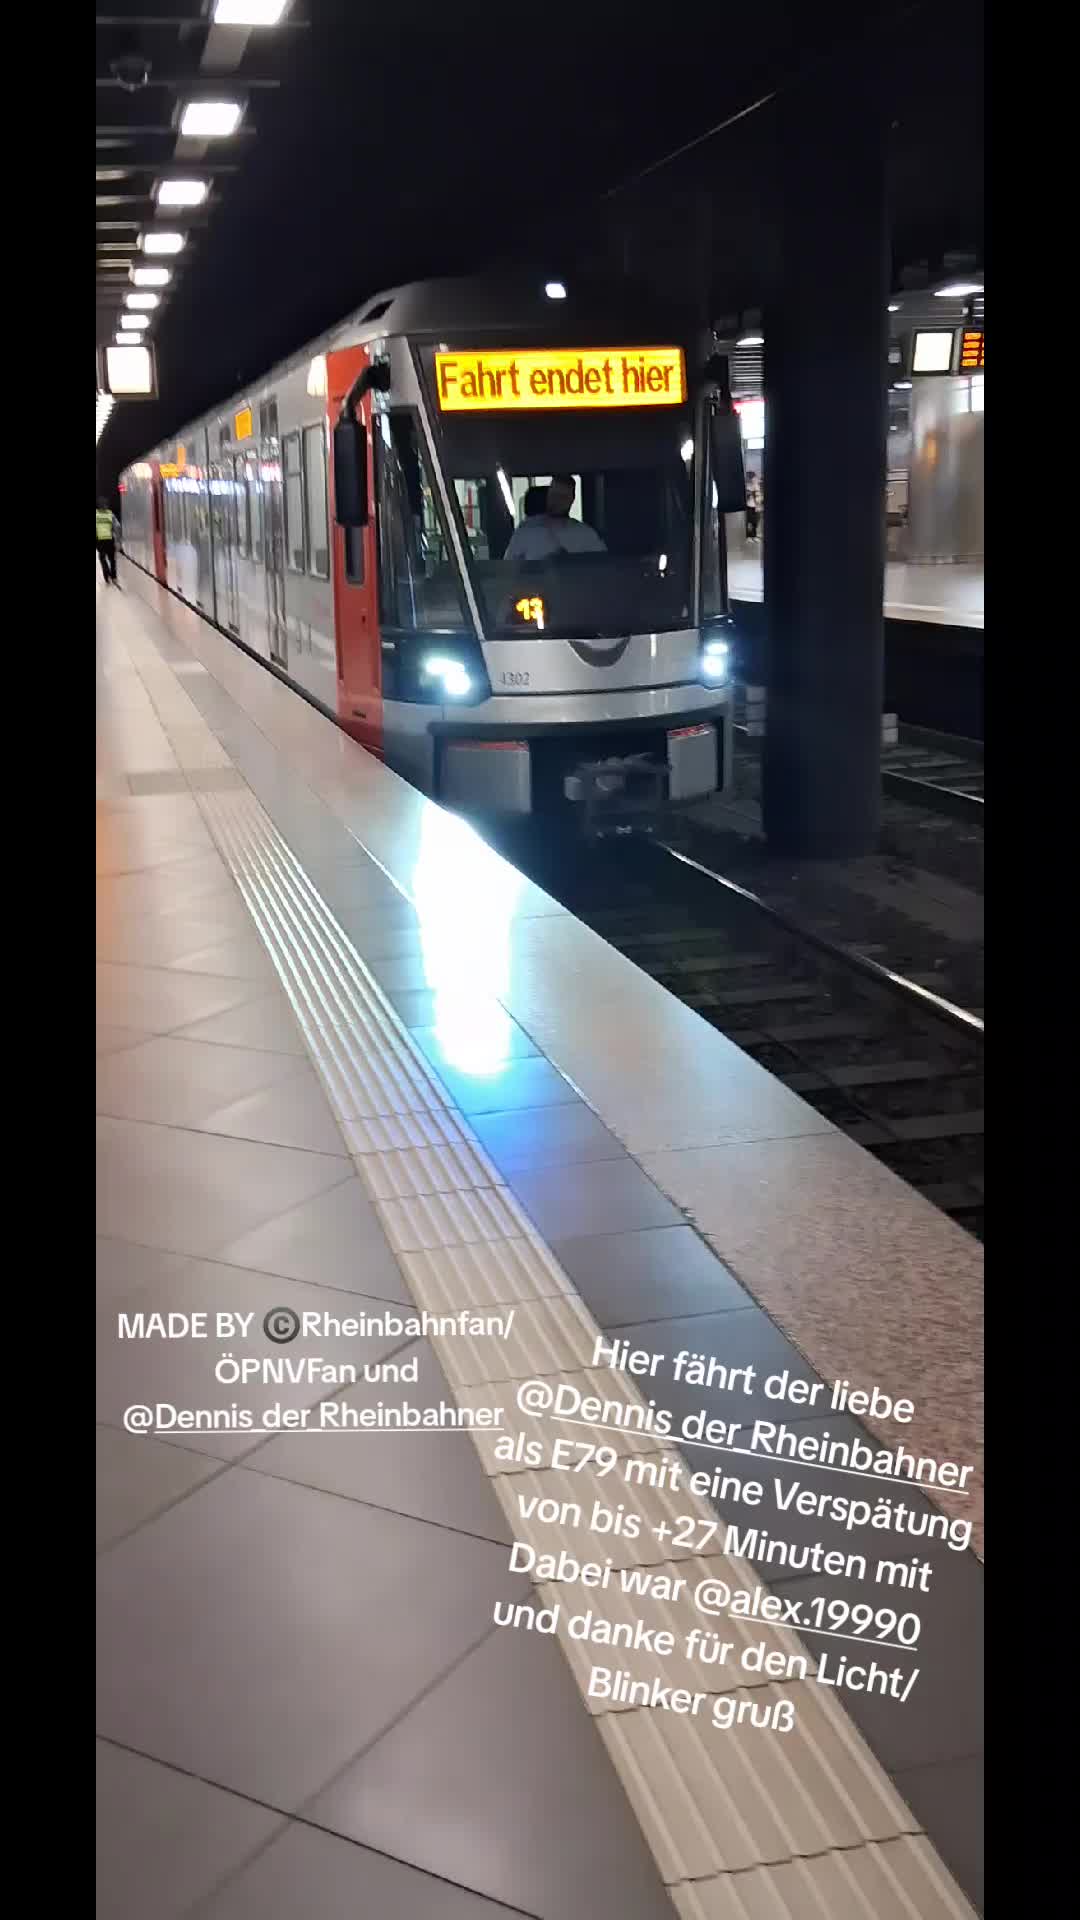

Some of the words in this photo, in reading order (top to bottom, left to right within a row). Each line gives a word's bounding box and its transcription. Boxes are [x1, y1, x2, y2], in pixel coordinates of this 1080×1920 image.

[439, 360, 521, 399] Fahrt
[529, 358, 615, 395] endet
[621, 356, 675, 394] hier
